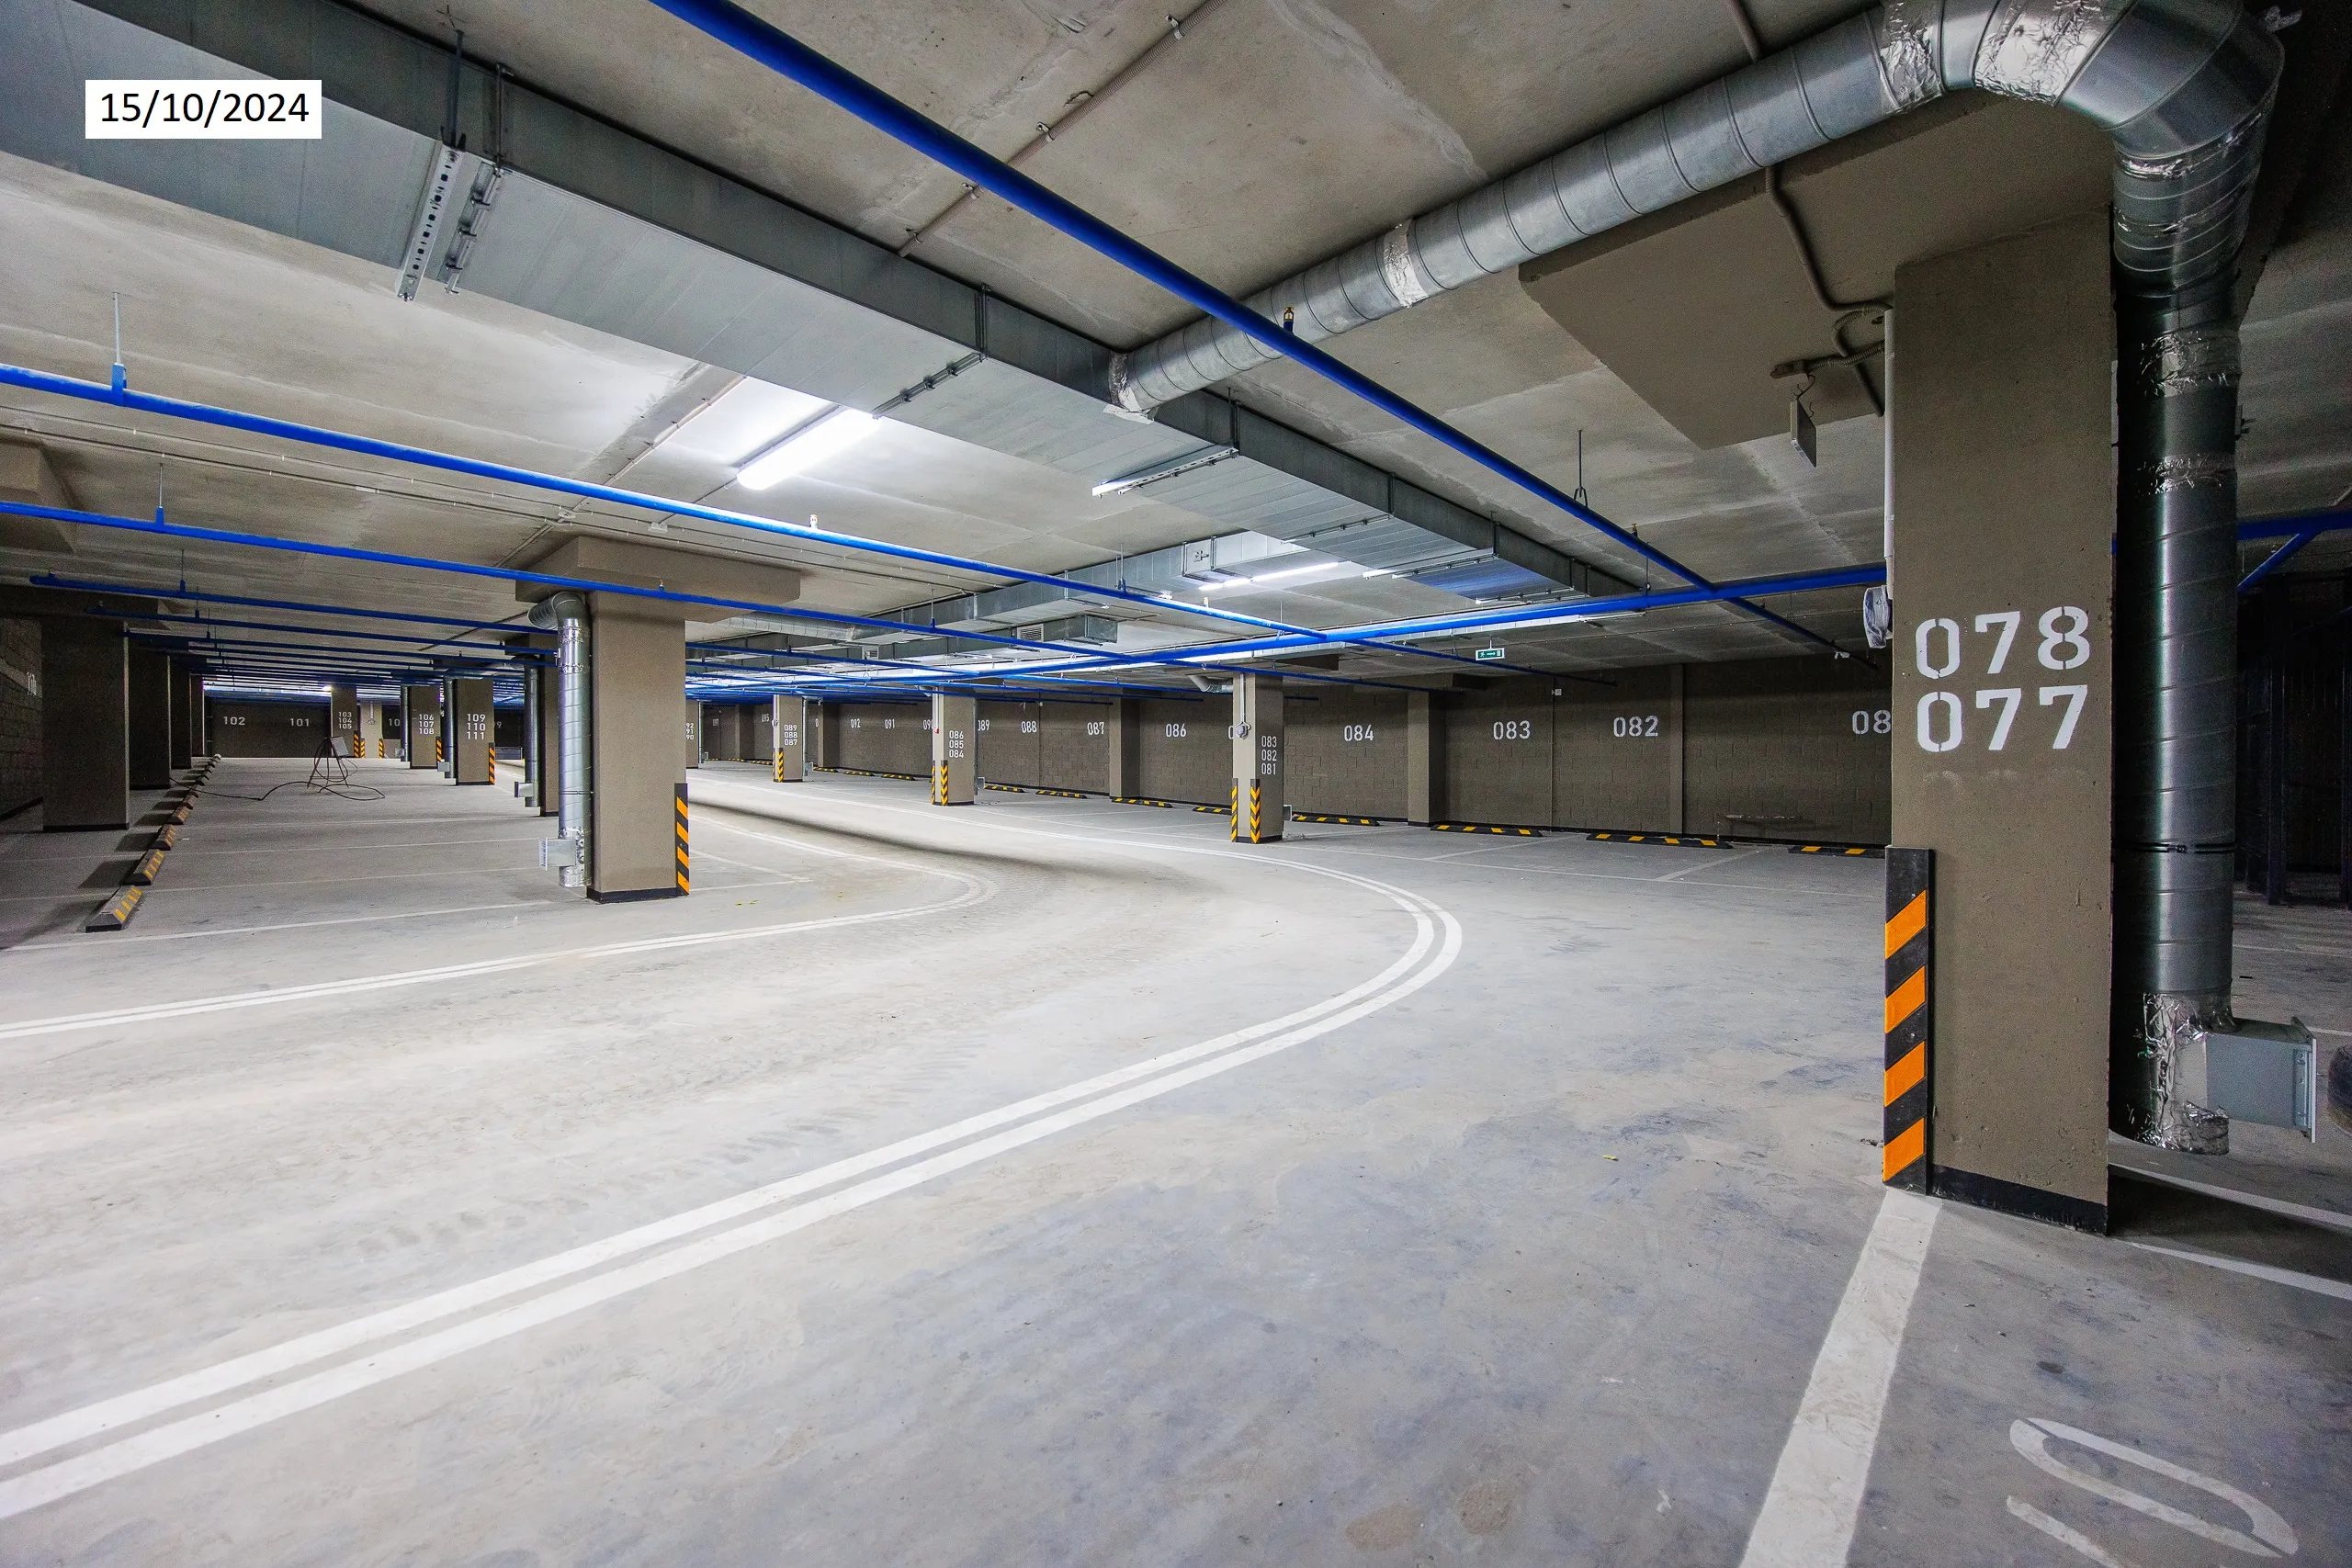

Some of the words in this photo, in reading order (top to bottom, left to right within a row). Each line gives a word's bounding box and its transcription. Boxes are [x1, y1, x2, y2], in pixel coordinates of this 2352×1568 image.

[1915, 605, 2090, 680] 078
[223, 716, 245, 726] 102
[290, 717, 310, 727] 101
[389, 718, 400, 727] 10
[467, 713, 486, 722] 109
[850, 718, 861, 728] 092
[1851, 710, 1892, 735] 08
[1917, 684, 2088, 752] 077
[467, 722, 486, 731] 110
[884, 718, 896, 729] 091
[922, 719, 933, 730] 09
[1021, 720, 1037, 733] 088
[1087, 722, 1105, 735] 087
[1613, 715, 1658, 738] 082
[467, 731, 485, 739] 111
[949, 730, 964, 739] 086
[1166, 723, 1187, 738] 086
[1343, 725, 1374, 742] 084
[1493, 720, 1531, 740] 083
[949, 739, 964, 749] 085
[1261, 736, 1277, 748] 083
[949, 750, 964, 758] 084
[1261, 750, 1277, 761] 082
[1261, 762, 1276, 775] 081
